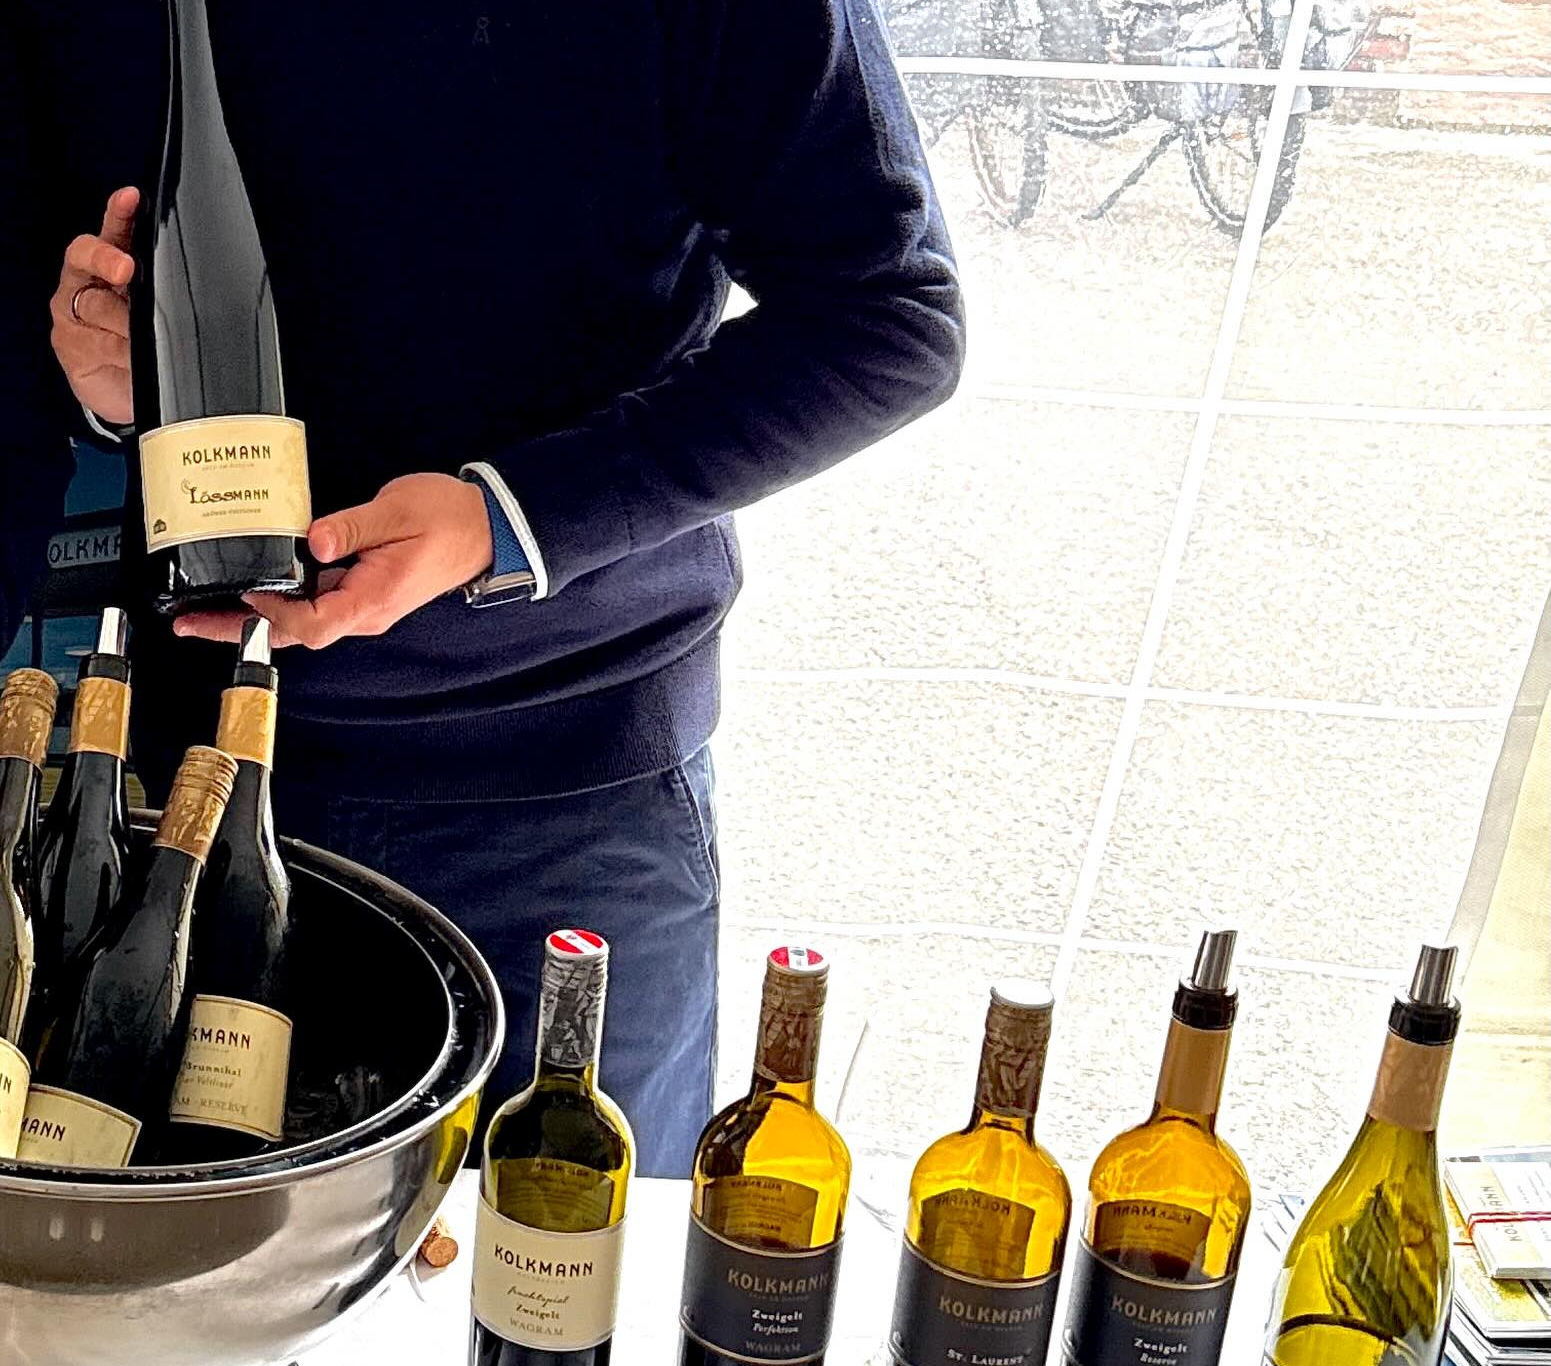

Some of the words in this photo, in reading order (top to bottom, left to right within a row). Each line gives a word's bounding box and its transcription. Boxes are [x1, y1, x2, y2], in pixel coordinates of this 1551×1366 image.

[182, 445, 271, 466] KOLKMANN
[493, 1243, 594, 1278] KOLKMANN
[727, 1268, 831, 1295] KOLKMANN
[515, 1303, 561, 1321] Zweigelt
[751, 1309, 803, 1324] Zweigelt
[938, 1295, 1044, 1325] KOLKMANN
[1110, 1294, 1217, 1327] KOLKMANN
[509, 1317, 564, 1337] WAGRAM
[745, 1340, 801, 1354] WAGRAM
[1133, 1337, 1188, 1356] Zweigelt
[1139, 1352, 1178, 1366] Reserve
